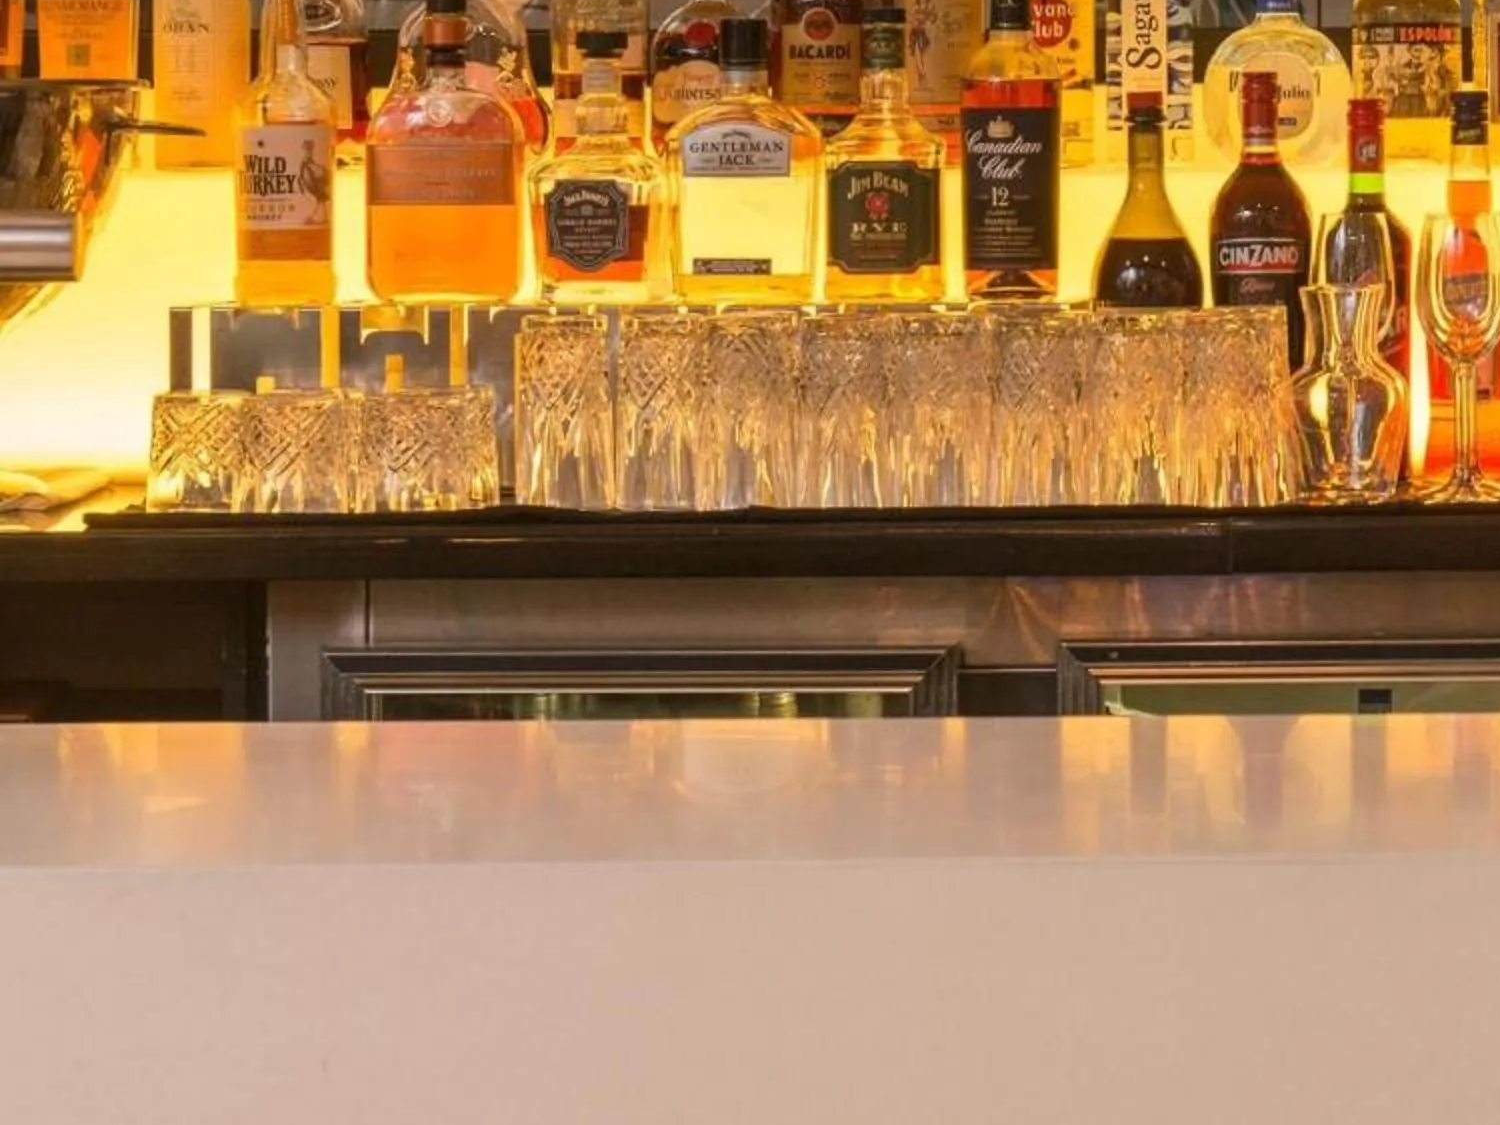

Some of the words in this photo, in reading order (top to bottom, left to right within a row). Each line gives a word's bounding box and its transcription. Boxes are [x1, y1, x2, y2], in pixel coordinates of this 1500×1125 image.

[1030, 19, 1065, 38] lub
[689, 140, 784, 153] GENTLEMAN
[965, 127, 1043, 154] Canadian
[243, 155, 287, 174] WILD
[718, 154, 755, 167] JACK
[990, 185, 1010, 207] 12
[1218, 244, 1300, 268] CINZANO
